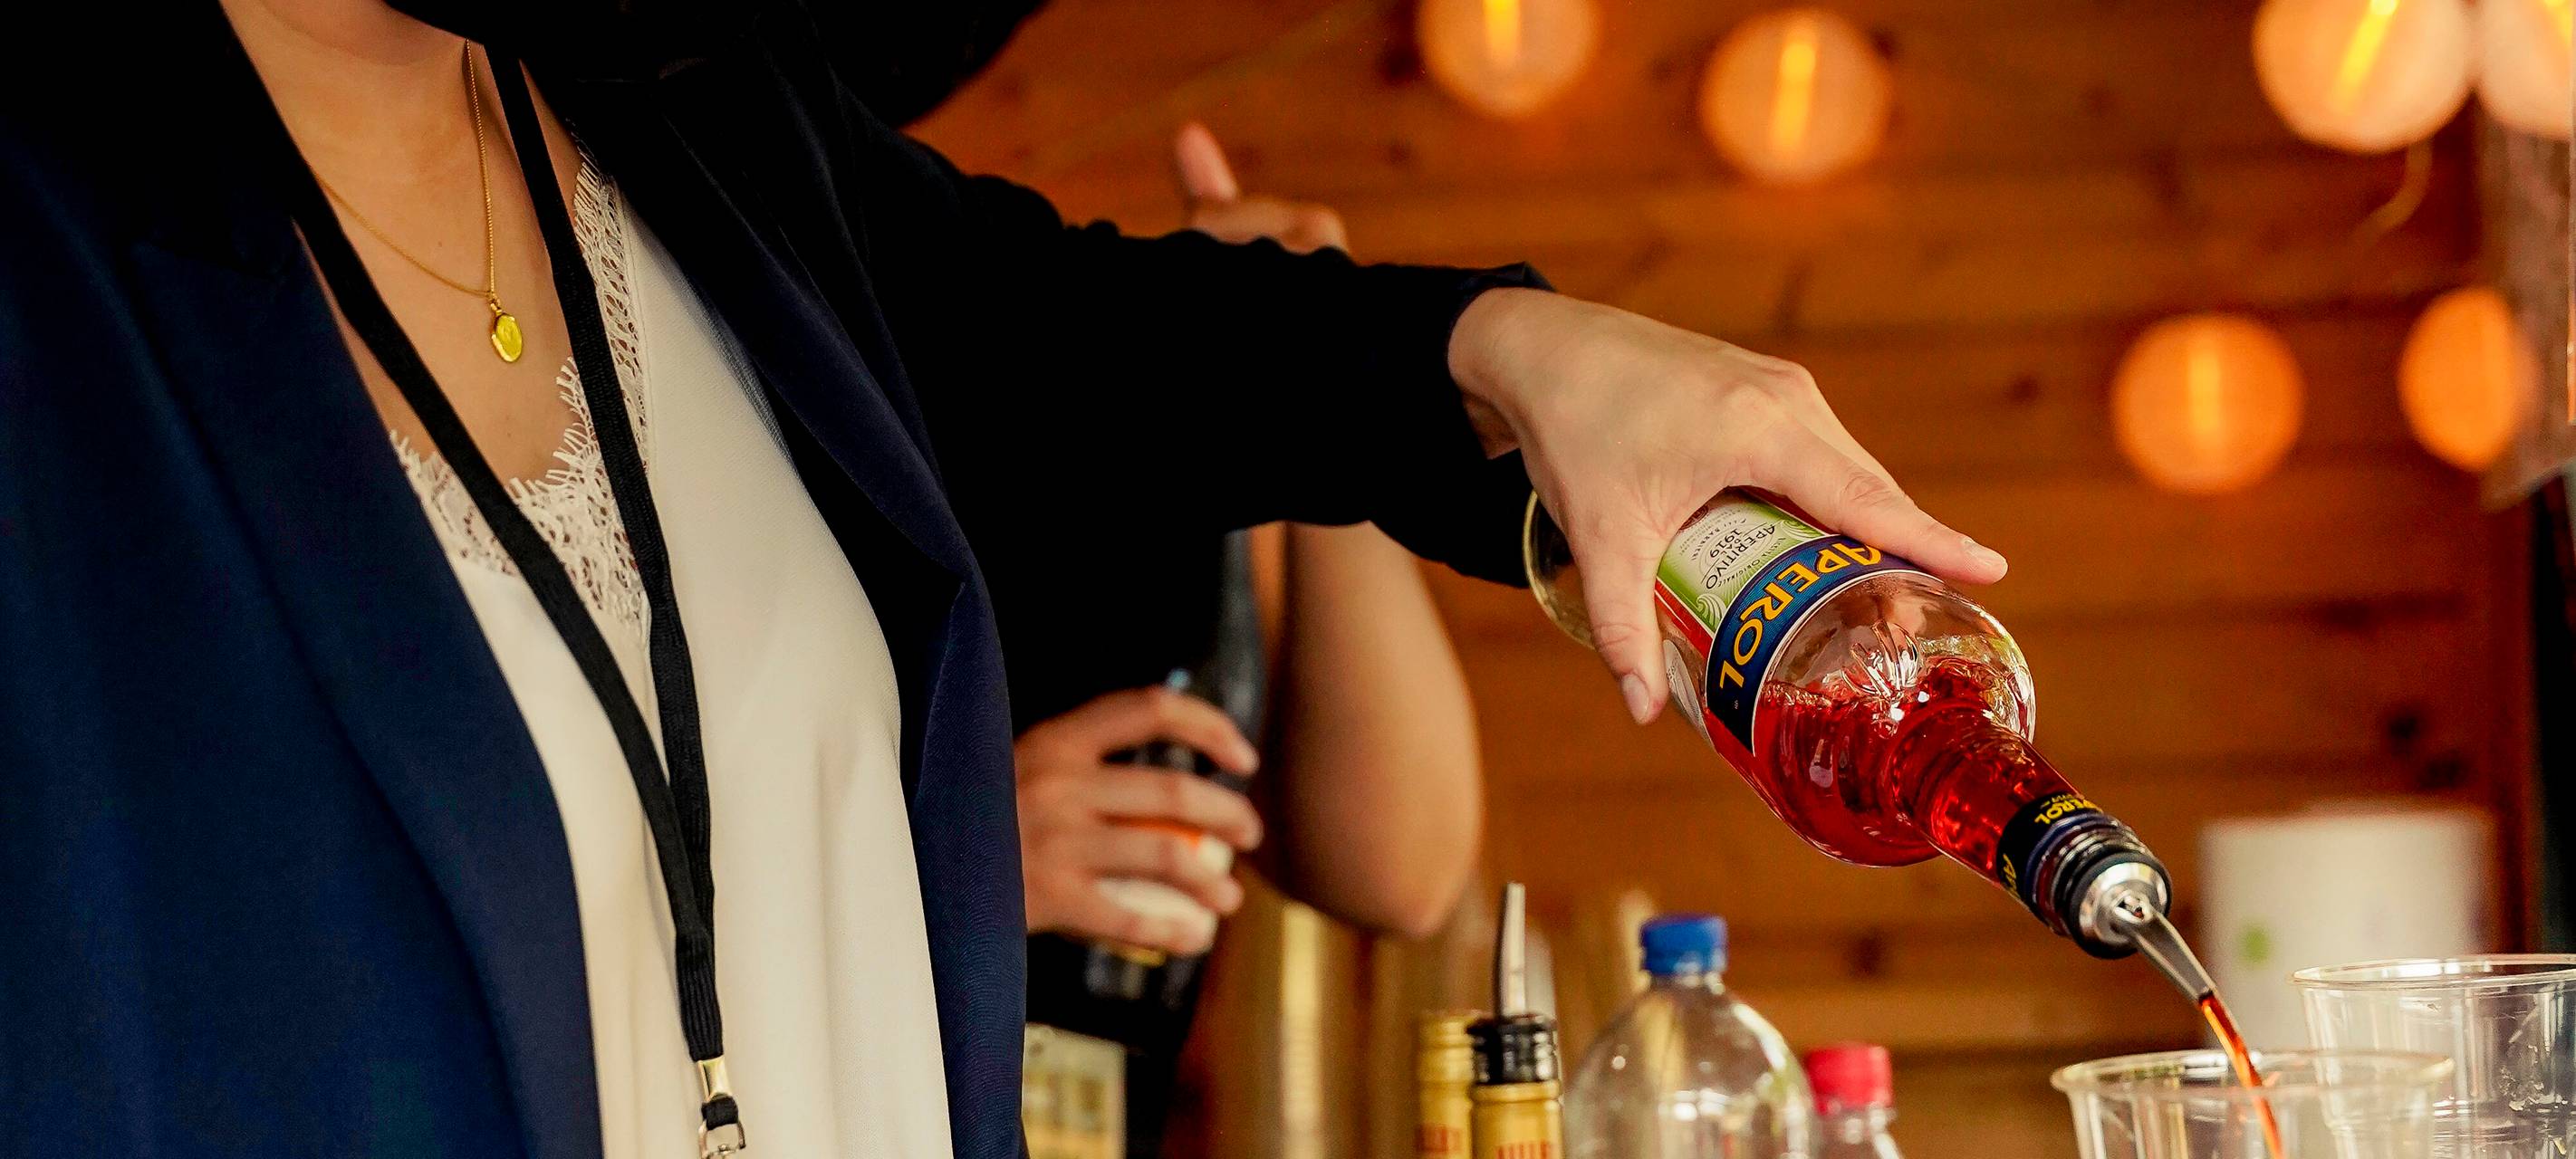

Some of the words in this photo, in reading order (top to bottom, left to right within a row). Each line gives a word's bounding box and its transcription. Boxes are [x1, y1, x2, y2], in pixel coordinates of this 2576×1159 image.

[1706, 524, 1775, 589] APERITIVO
[1710, 528, 1742, 558] 1919
[1720, 538, 1741, 555] DAL
[1719, 543, 1882, 690] APEROL
[2034, 799, 2099, 824] PEROL
